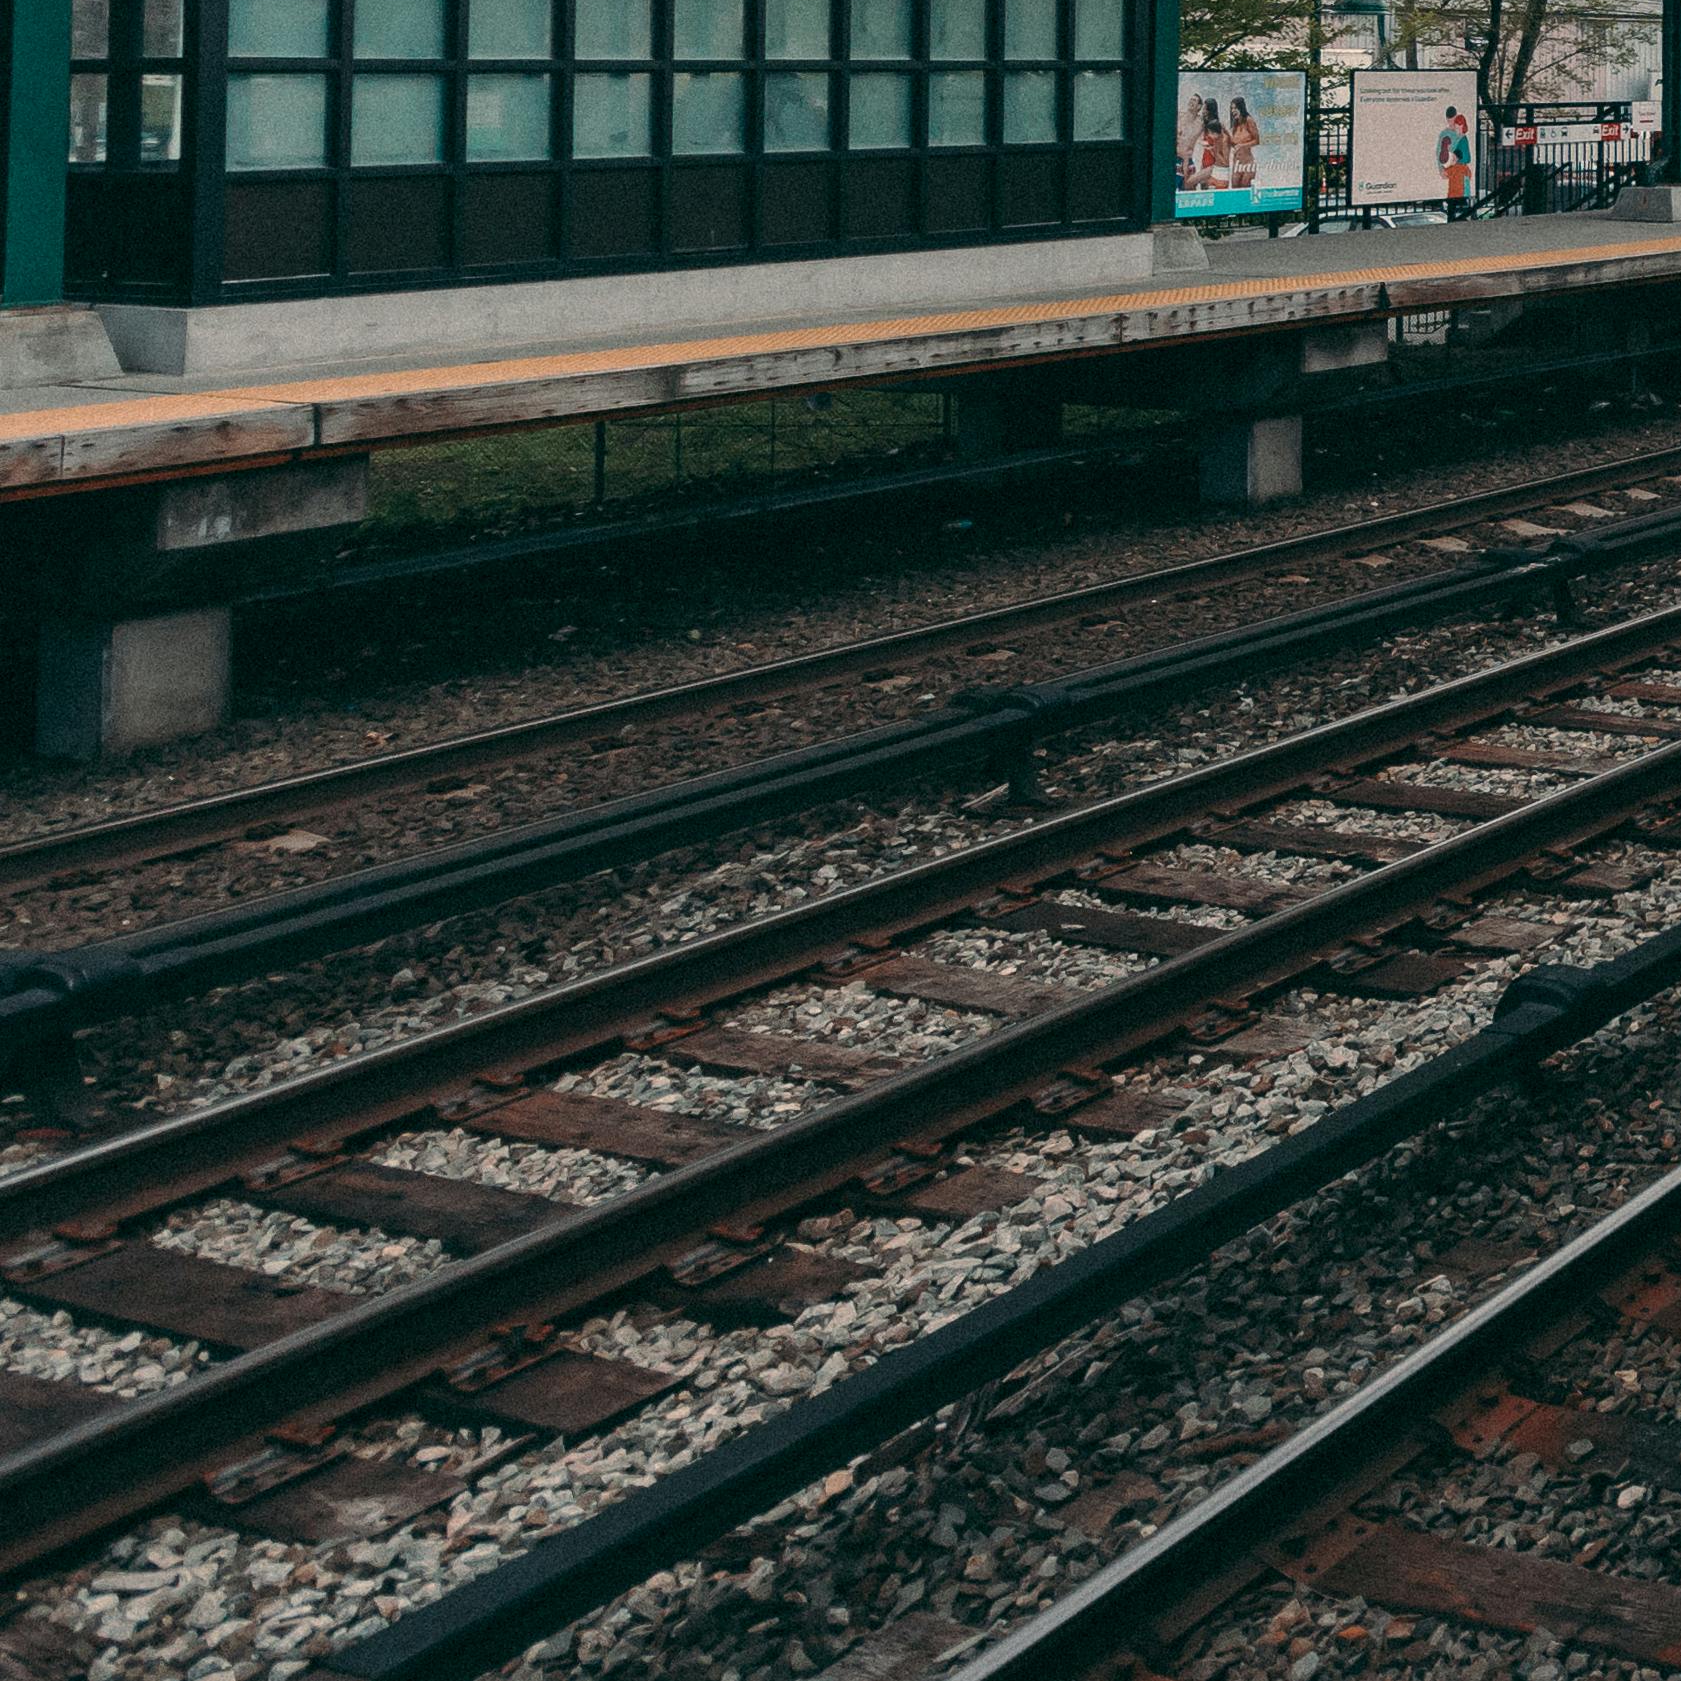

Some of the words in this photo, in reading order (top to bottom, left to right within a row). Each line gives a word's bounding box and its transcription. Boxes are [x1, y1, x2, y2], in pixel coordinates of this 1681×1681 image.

[1515, 129, 1536, 140] Exit
[1602, 124, 1620, 136] Exit
[1366, 182, 1398, 191] Guardian
